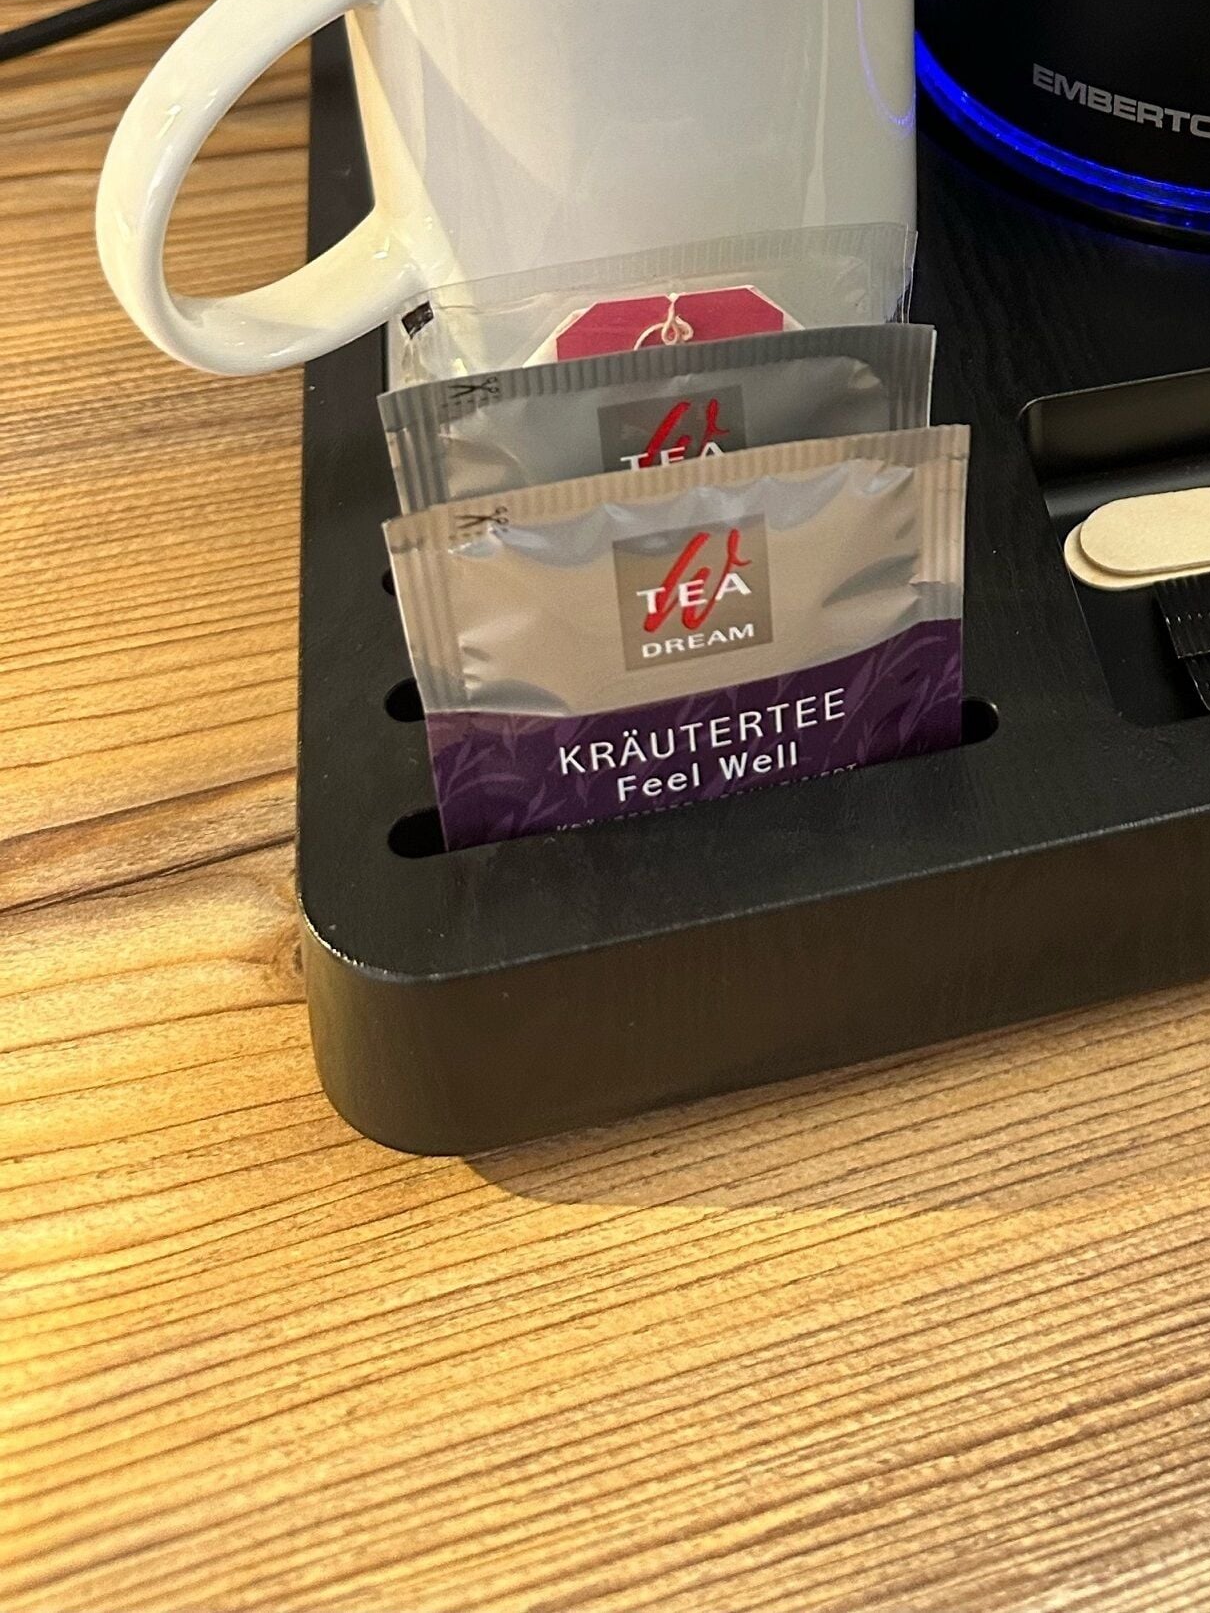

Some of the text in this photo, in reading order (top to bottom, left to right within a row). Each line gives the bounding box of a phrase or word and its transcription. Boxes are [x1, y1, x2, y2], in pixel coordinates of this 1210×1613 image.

[636, 572, 752, 615] TEA
[641, 623, 755, 658] DREAM
[558, 687, 847, 776] KRÄUTERTEE
[616, 769, 702, 803] Feel
[719, 743, 799, 781] Well
